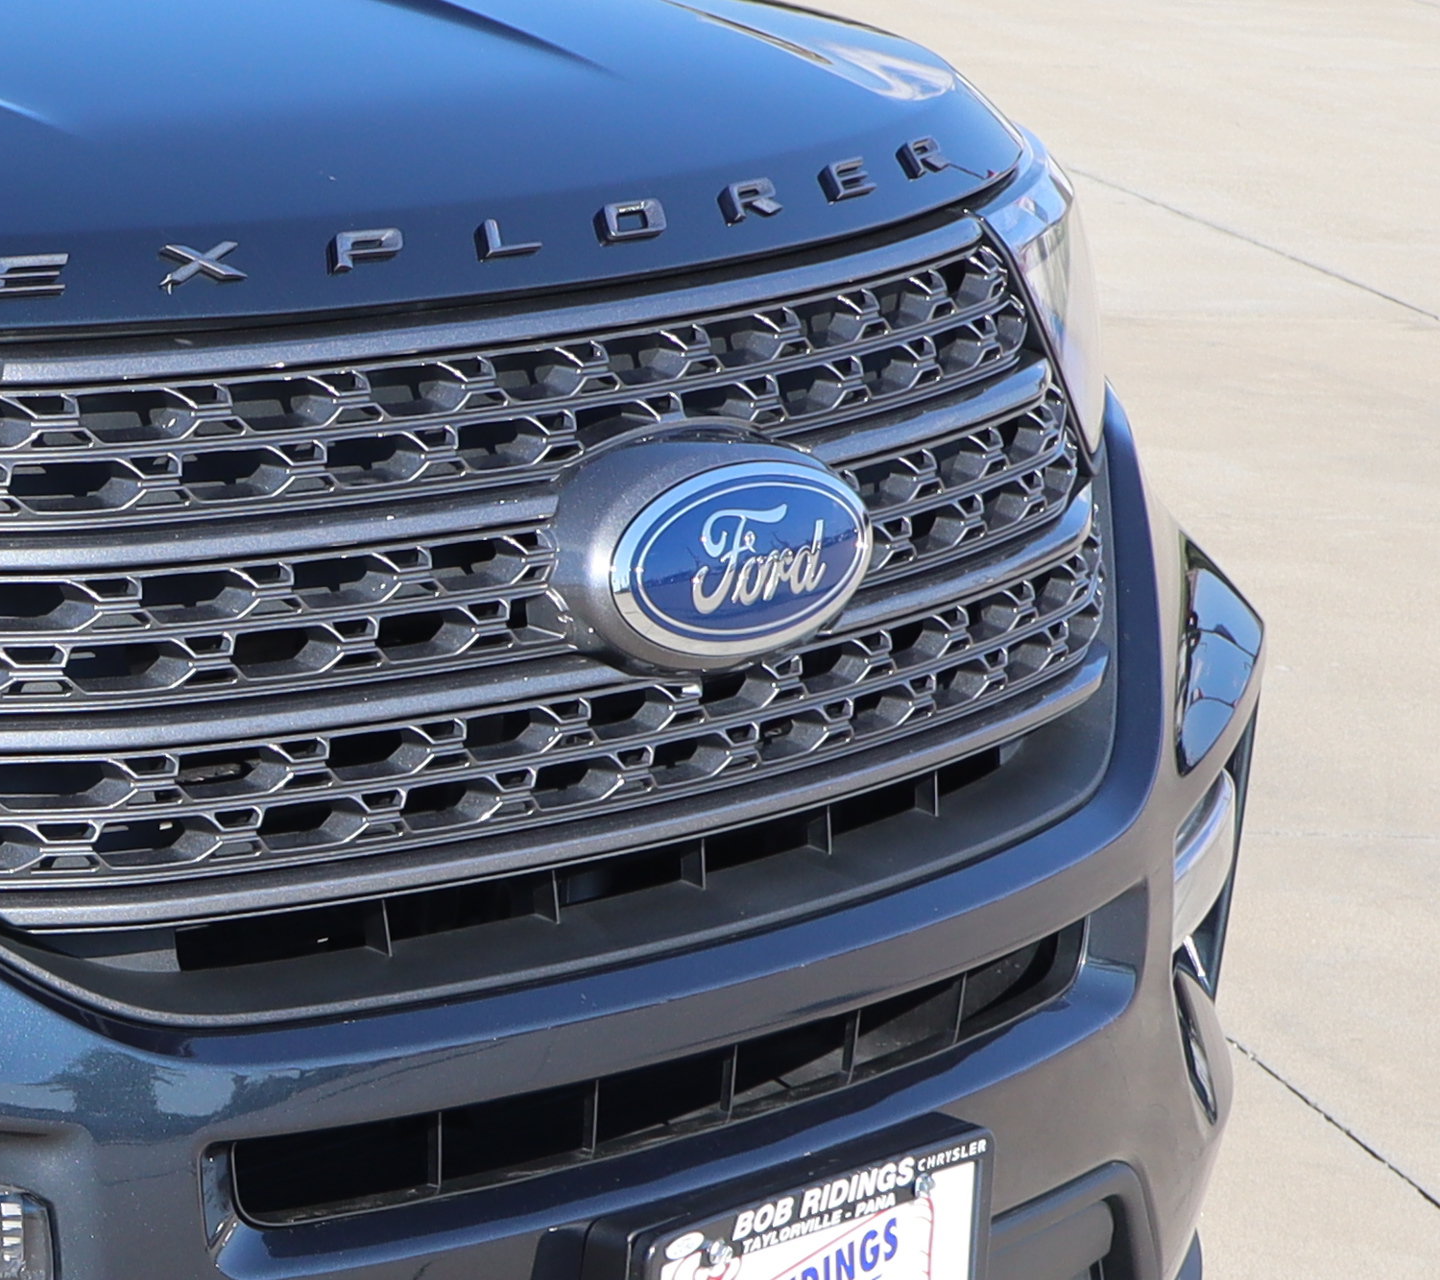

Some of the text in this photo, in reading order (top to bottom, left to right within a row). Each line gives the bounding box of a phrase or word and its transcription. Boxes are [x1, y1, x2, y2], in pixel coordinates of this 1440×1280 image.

[692, 503, 827, 614] Ford
[917, 1138, 987, 1172] CHRYSLER
[732, 1156, 915, 1241] BOB RIDINGS
[742, 1210, 843, 1255] TAYLORVILLE
[855, 1192, 896, 1218] PANA
